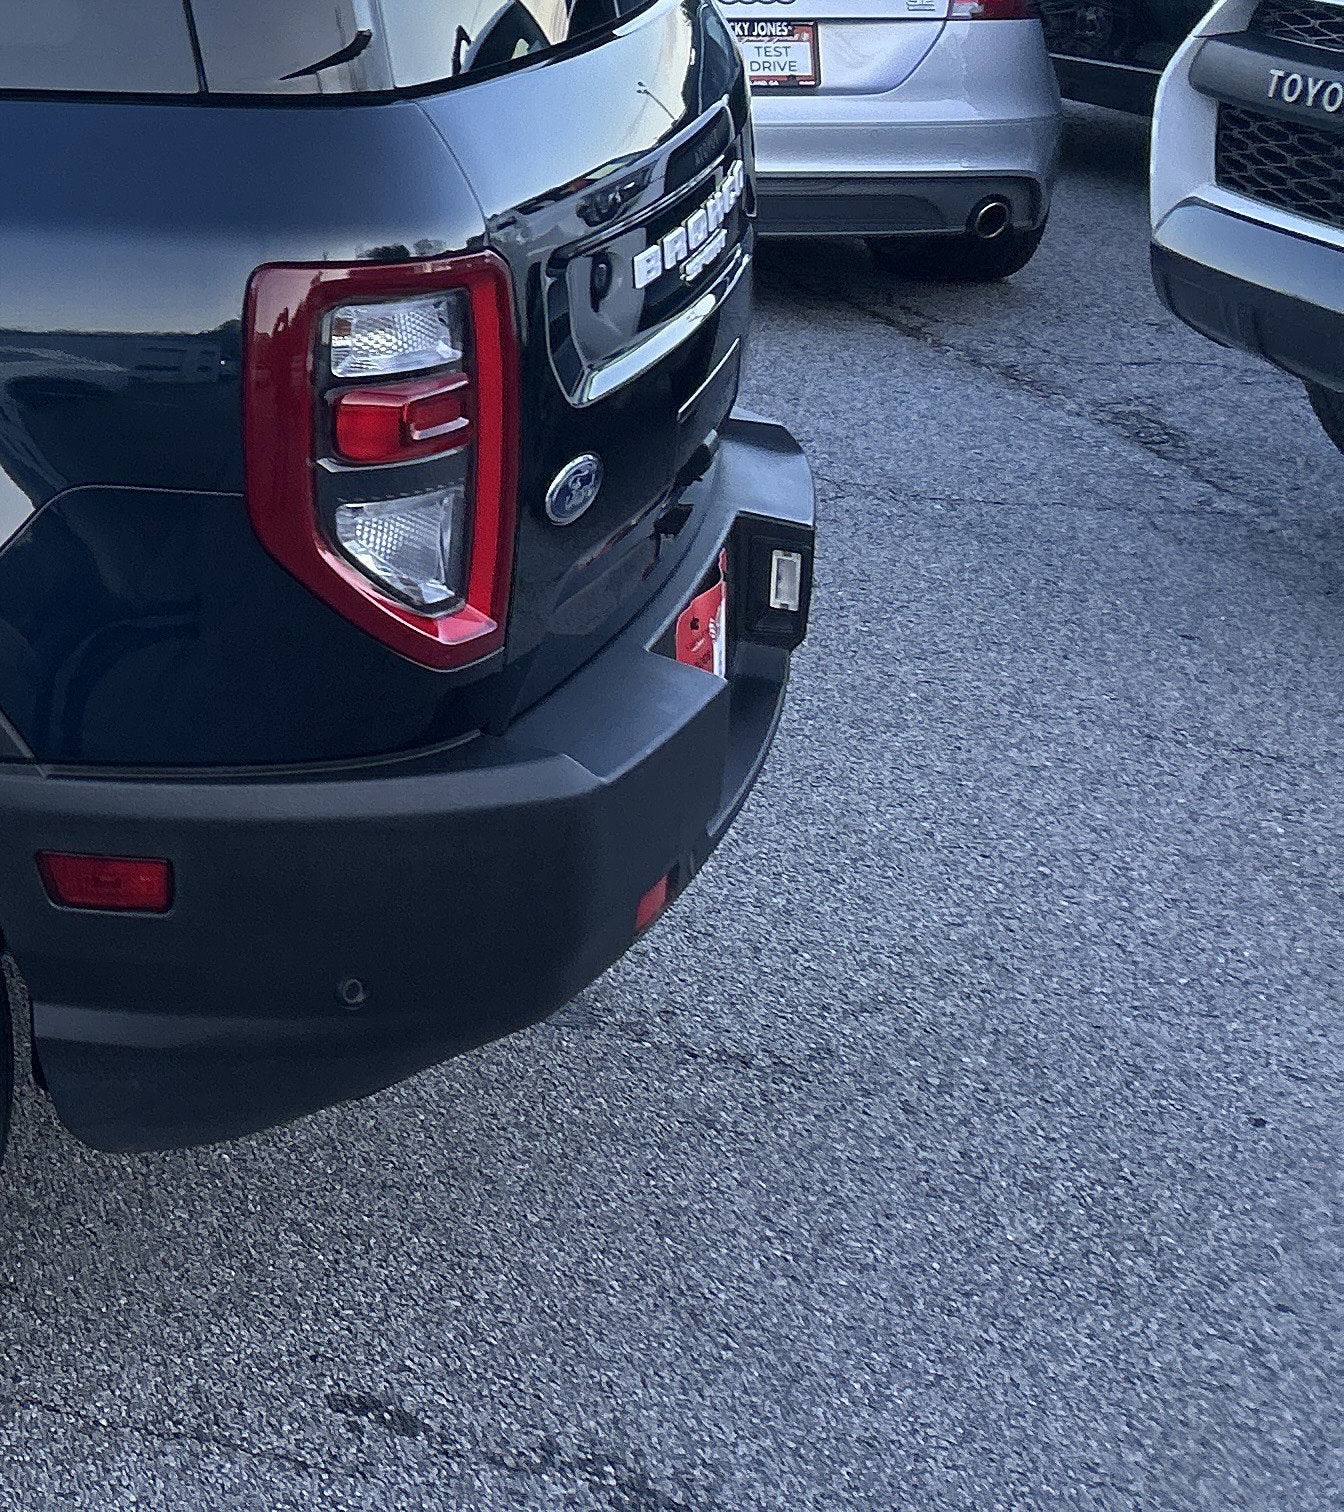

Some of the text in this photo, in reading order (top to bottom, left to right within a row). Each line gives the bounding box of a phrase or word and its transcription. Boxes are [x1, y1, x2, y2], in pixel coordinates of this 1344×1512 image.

[752, 21, 789, 36] JONES
[754, 45, 792, 58] TEST
[749, 60, 798, 72] DRIVE
[1268, 69, 1344, 113] TOYO
